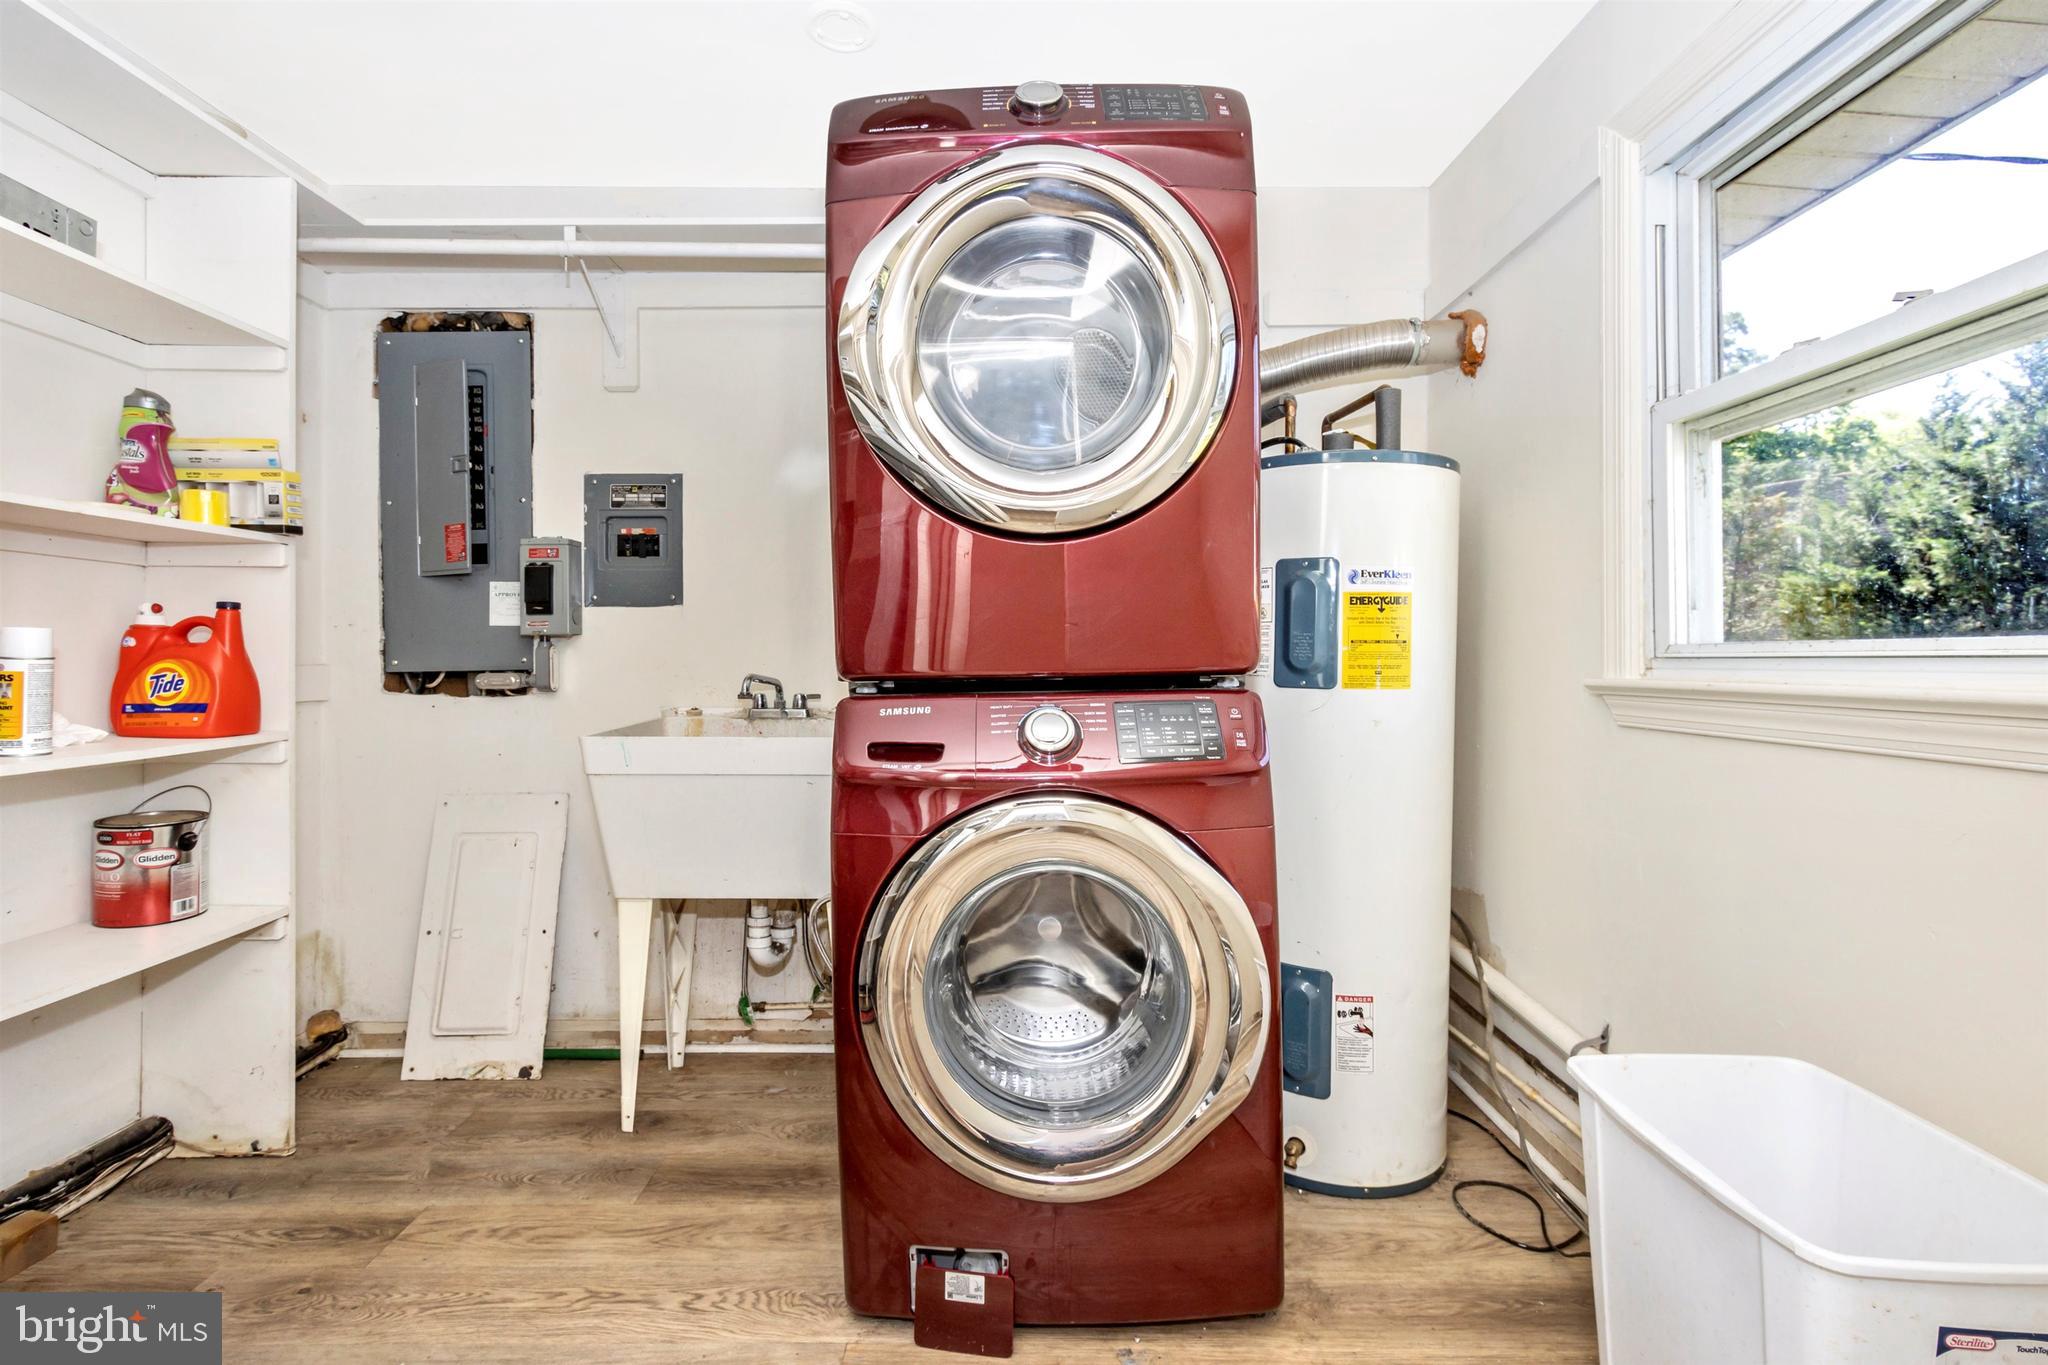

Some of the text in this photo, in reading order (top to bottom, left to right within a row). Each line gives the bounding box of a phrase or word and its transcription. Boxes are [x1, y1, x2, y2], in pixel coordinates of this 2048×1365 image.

[1360, 569, 1412, 580] EverKleen
[1349, 596, 1409, 608] ENERGYGUIDE
[149, 673, 185, 699] Tide
[879, 706, 932, 717] SAMSUNG
[138, 852, 176, 863] Glidden
[1950, 1336, 1989, 1348] Sterilite
